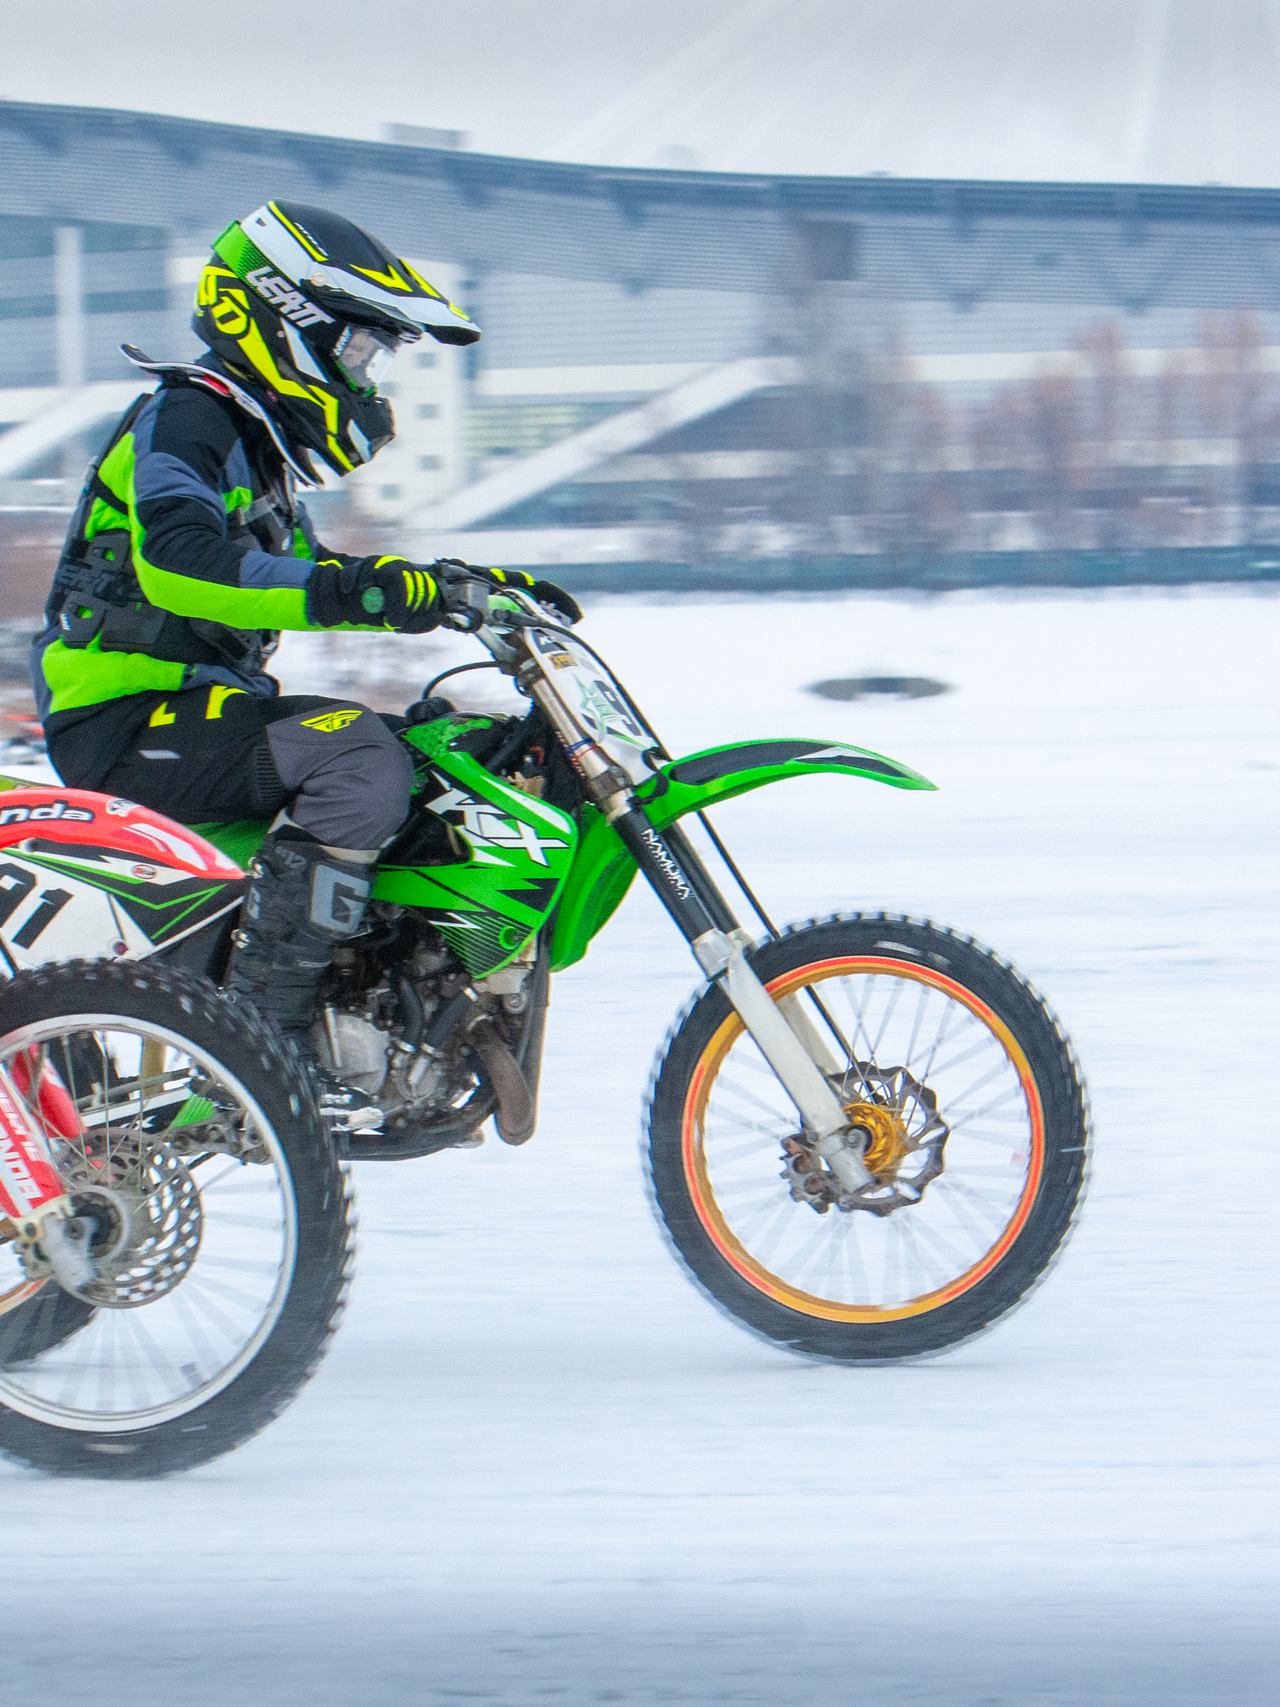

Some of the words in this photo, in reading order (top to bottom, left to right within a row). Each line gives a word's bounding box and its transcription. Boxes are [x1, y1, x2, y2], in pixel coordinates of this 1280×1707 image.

[246, 266, 336, 328] LEATT
[424, 787, 570, 869] KX
[641, 828, 692, 900] NAMURA
